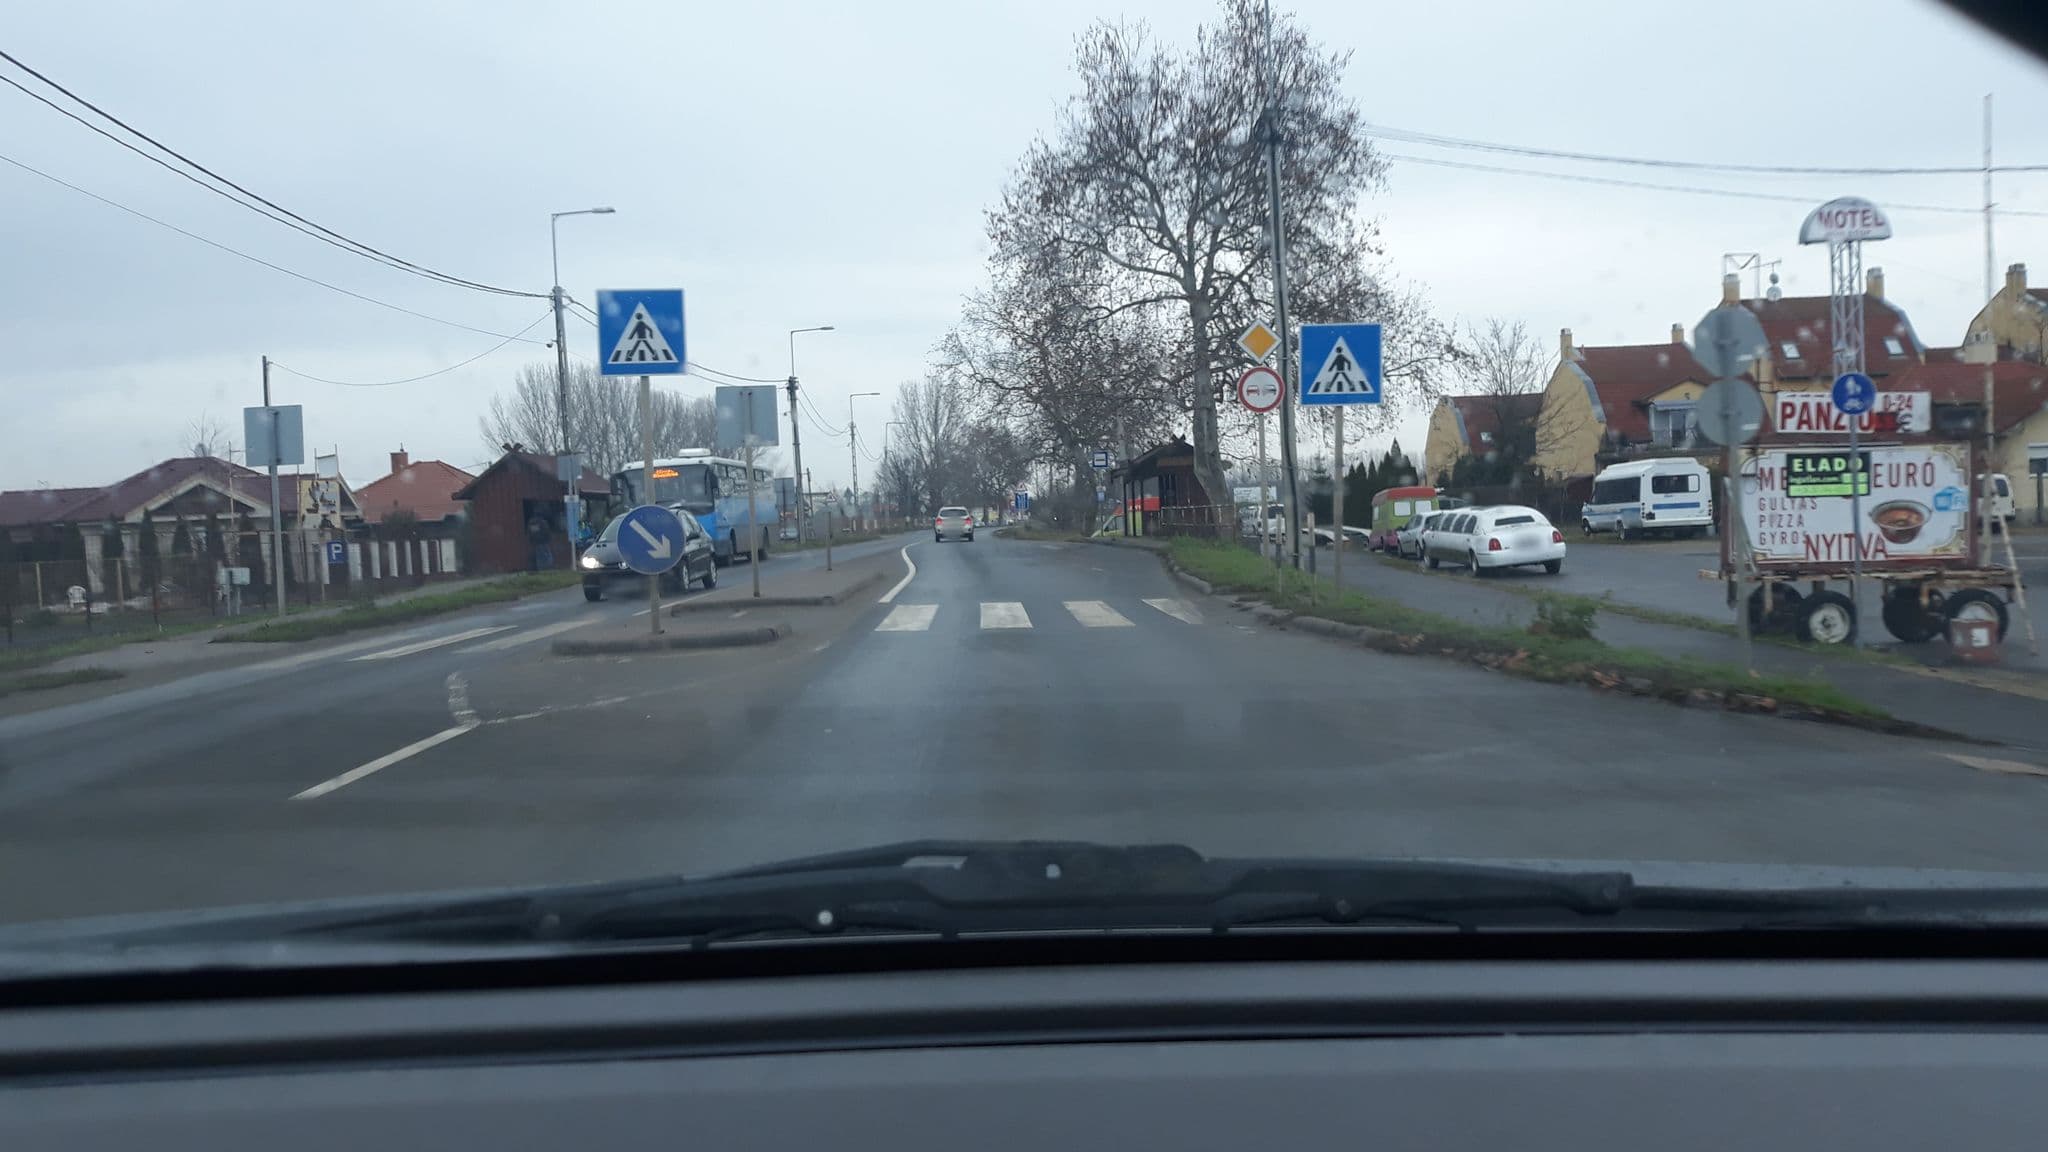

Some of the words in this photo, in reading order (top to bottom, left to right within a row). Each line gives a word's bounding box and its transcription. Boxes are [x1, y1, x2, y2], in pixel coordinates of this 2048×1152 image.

[1817, 208, 1886, 229] MOTEL
[1873, 457, 1936, 488] EURÓ
[1759, 513, 1805, 528] PIZZA
[331, 543, 343, 560] P
[1805, 532, 1889, 561] NYITVA
